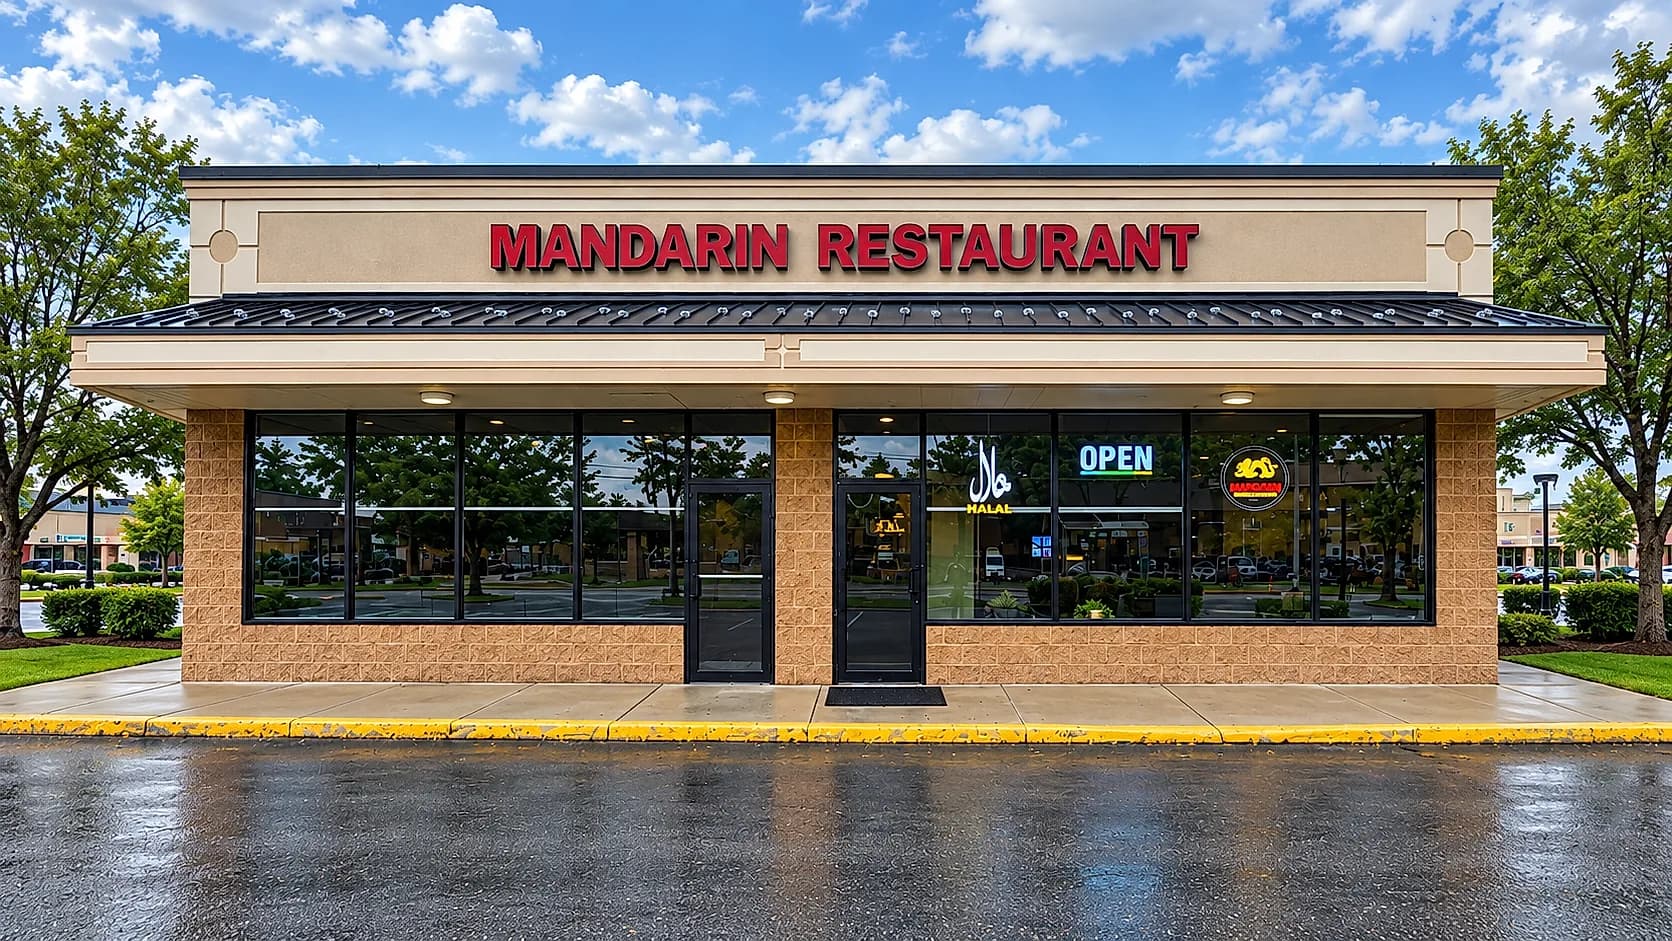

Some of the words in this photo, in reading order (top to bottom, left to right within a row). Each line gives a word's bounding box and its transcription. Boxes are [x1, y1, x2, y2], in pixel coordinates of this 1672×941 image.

[490, 223, 788, 270] MANDARIN
[817, 223, 1200, 270] RESTAURANT
[1080, 445, 1153, 471] OPEN
[966, 503, 1012, 514] HALAL
